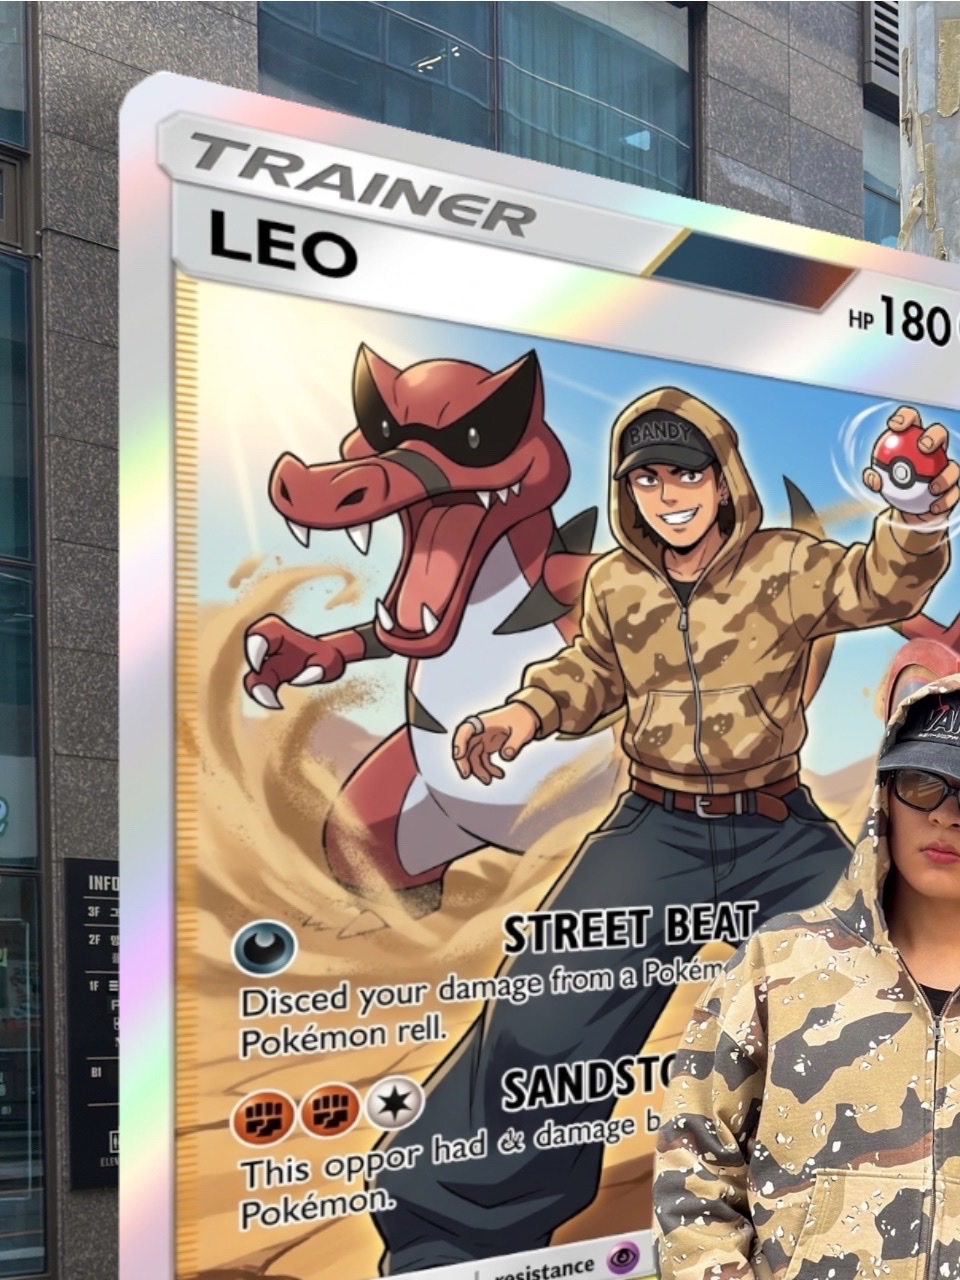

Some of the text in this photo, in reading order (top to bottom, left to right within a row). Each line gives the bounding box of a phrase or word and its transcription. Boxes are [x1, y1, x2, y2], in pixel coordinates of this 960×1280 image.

[87, 906, 100, 917] 3F
[88, 934, 101, 945] 2F
[89, 981, 99, 991] 1F
